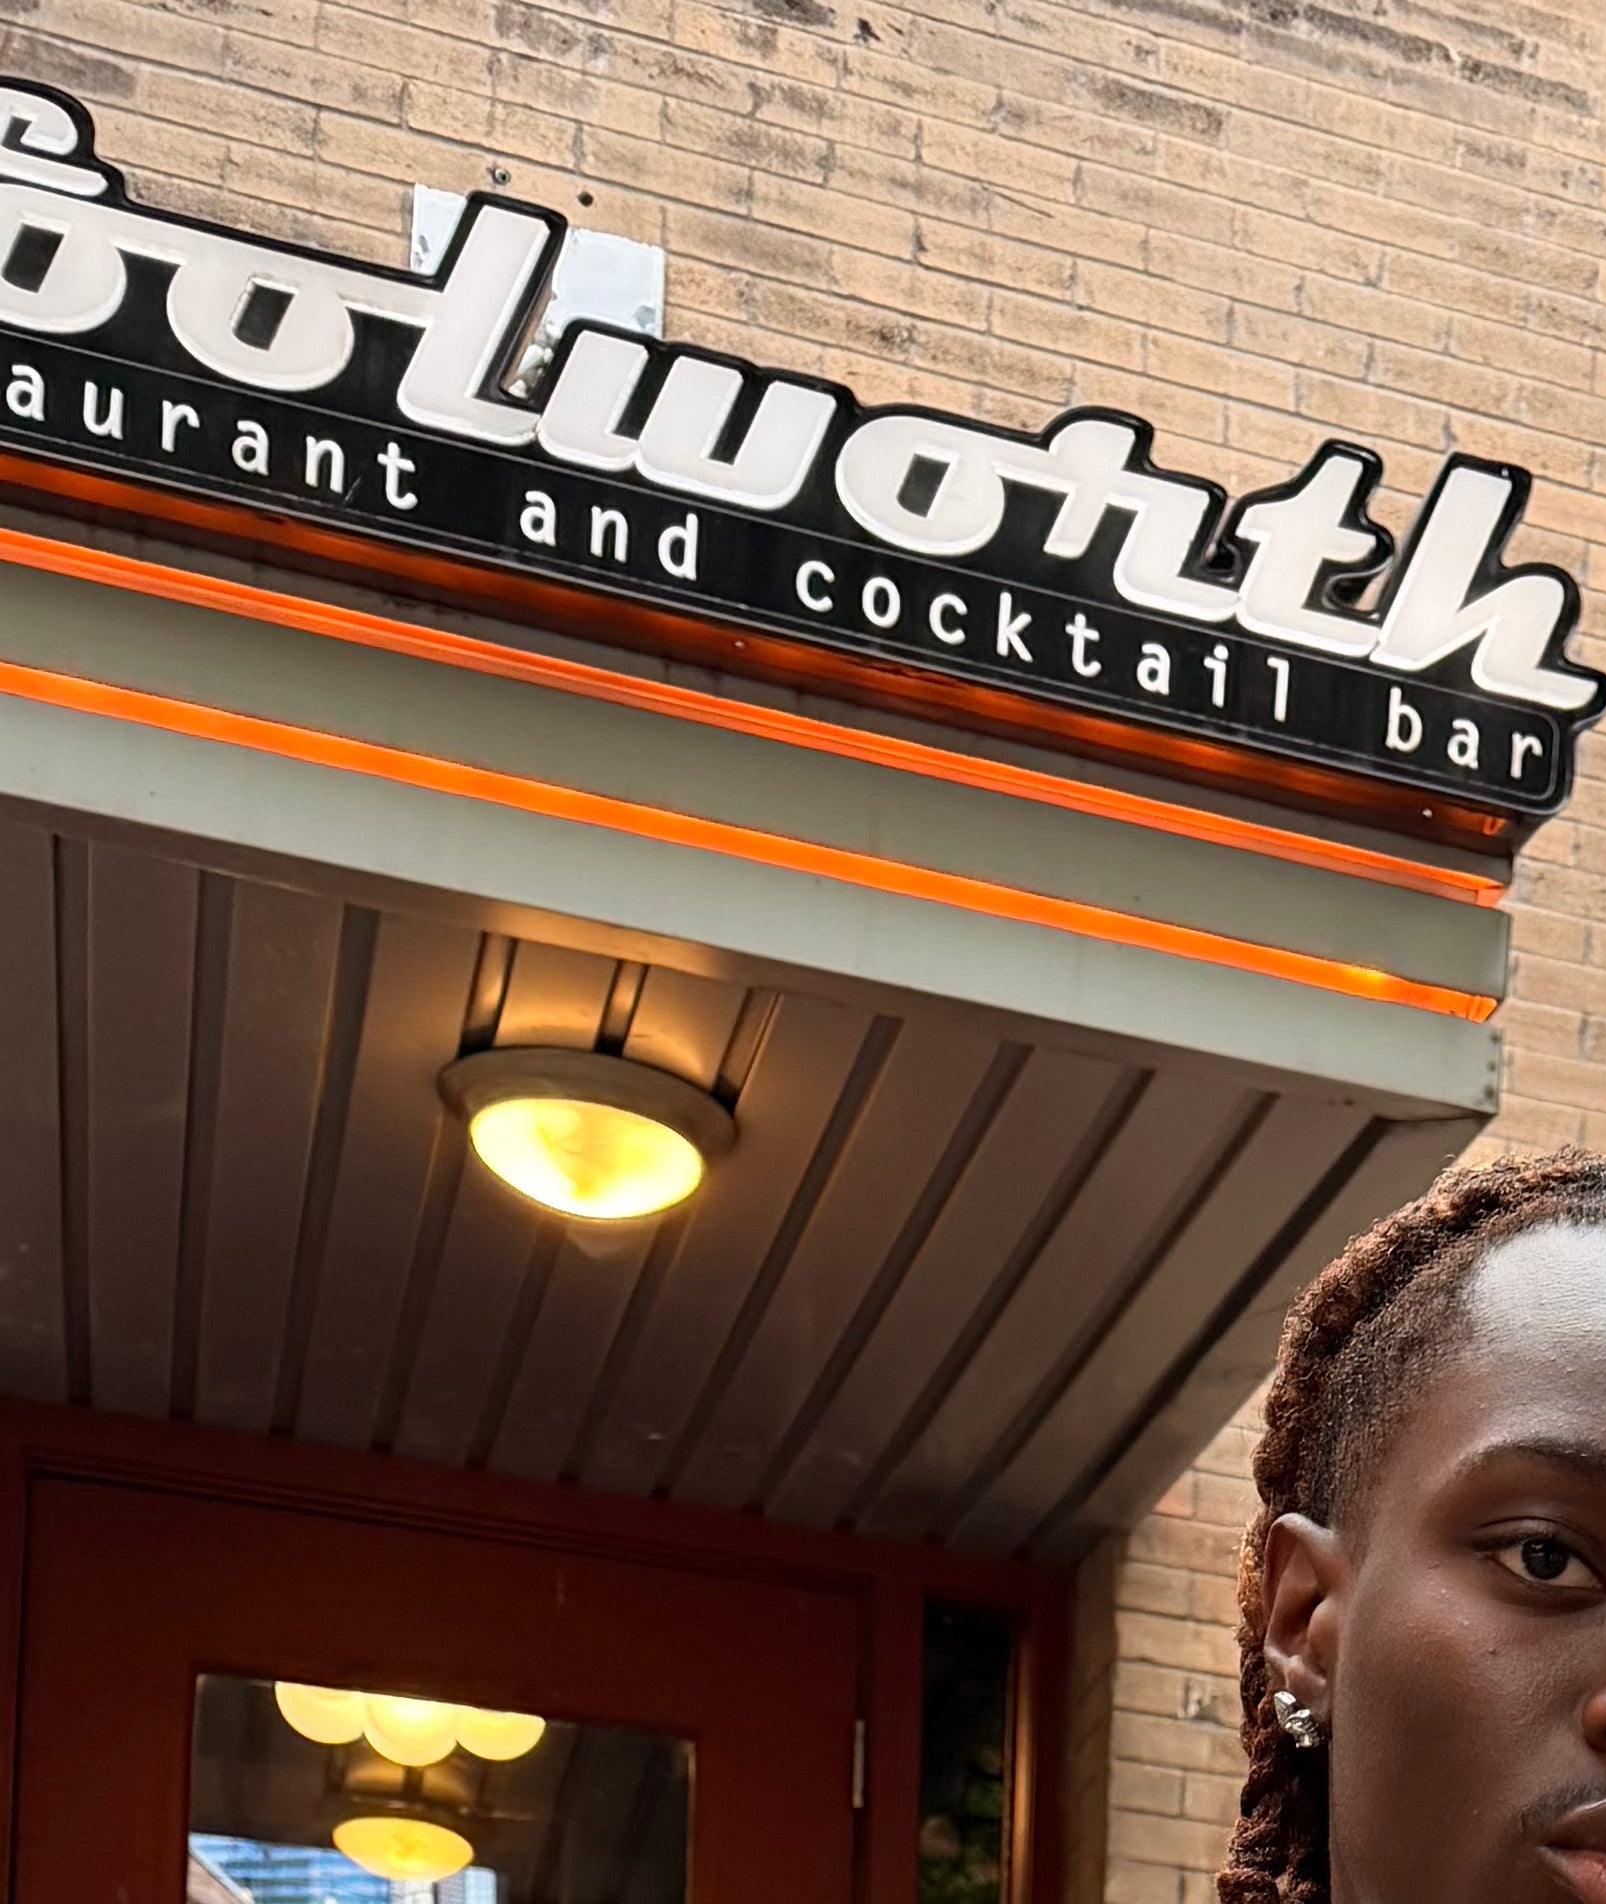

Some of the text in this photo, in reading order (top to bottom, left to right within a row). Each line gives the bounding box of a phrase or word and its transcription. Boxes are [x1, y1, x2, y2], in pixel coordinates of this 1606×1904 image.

[5, 362, 1544, 779] aurant and cocktail bar
